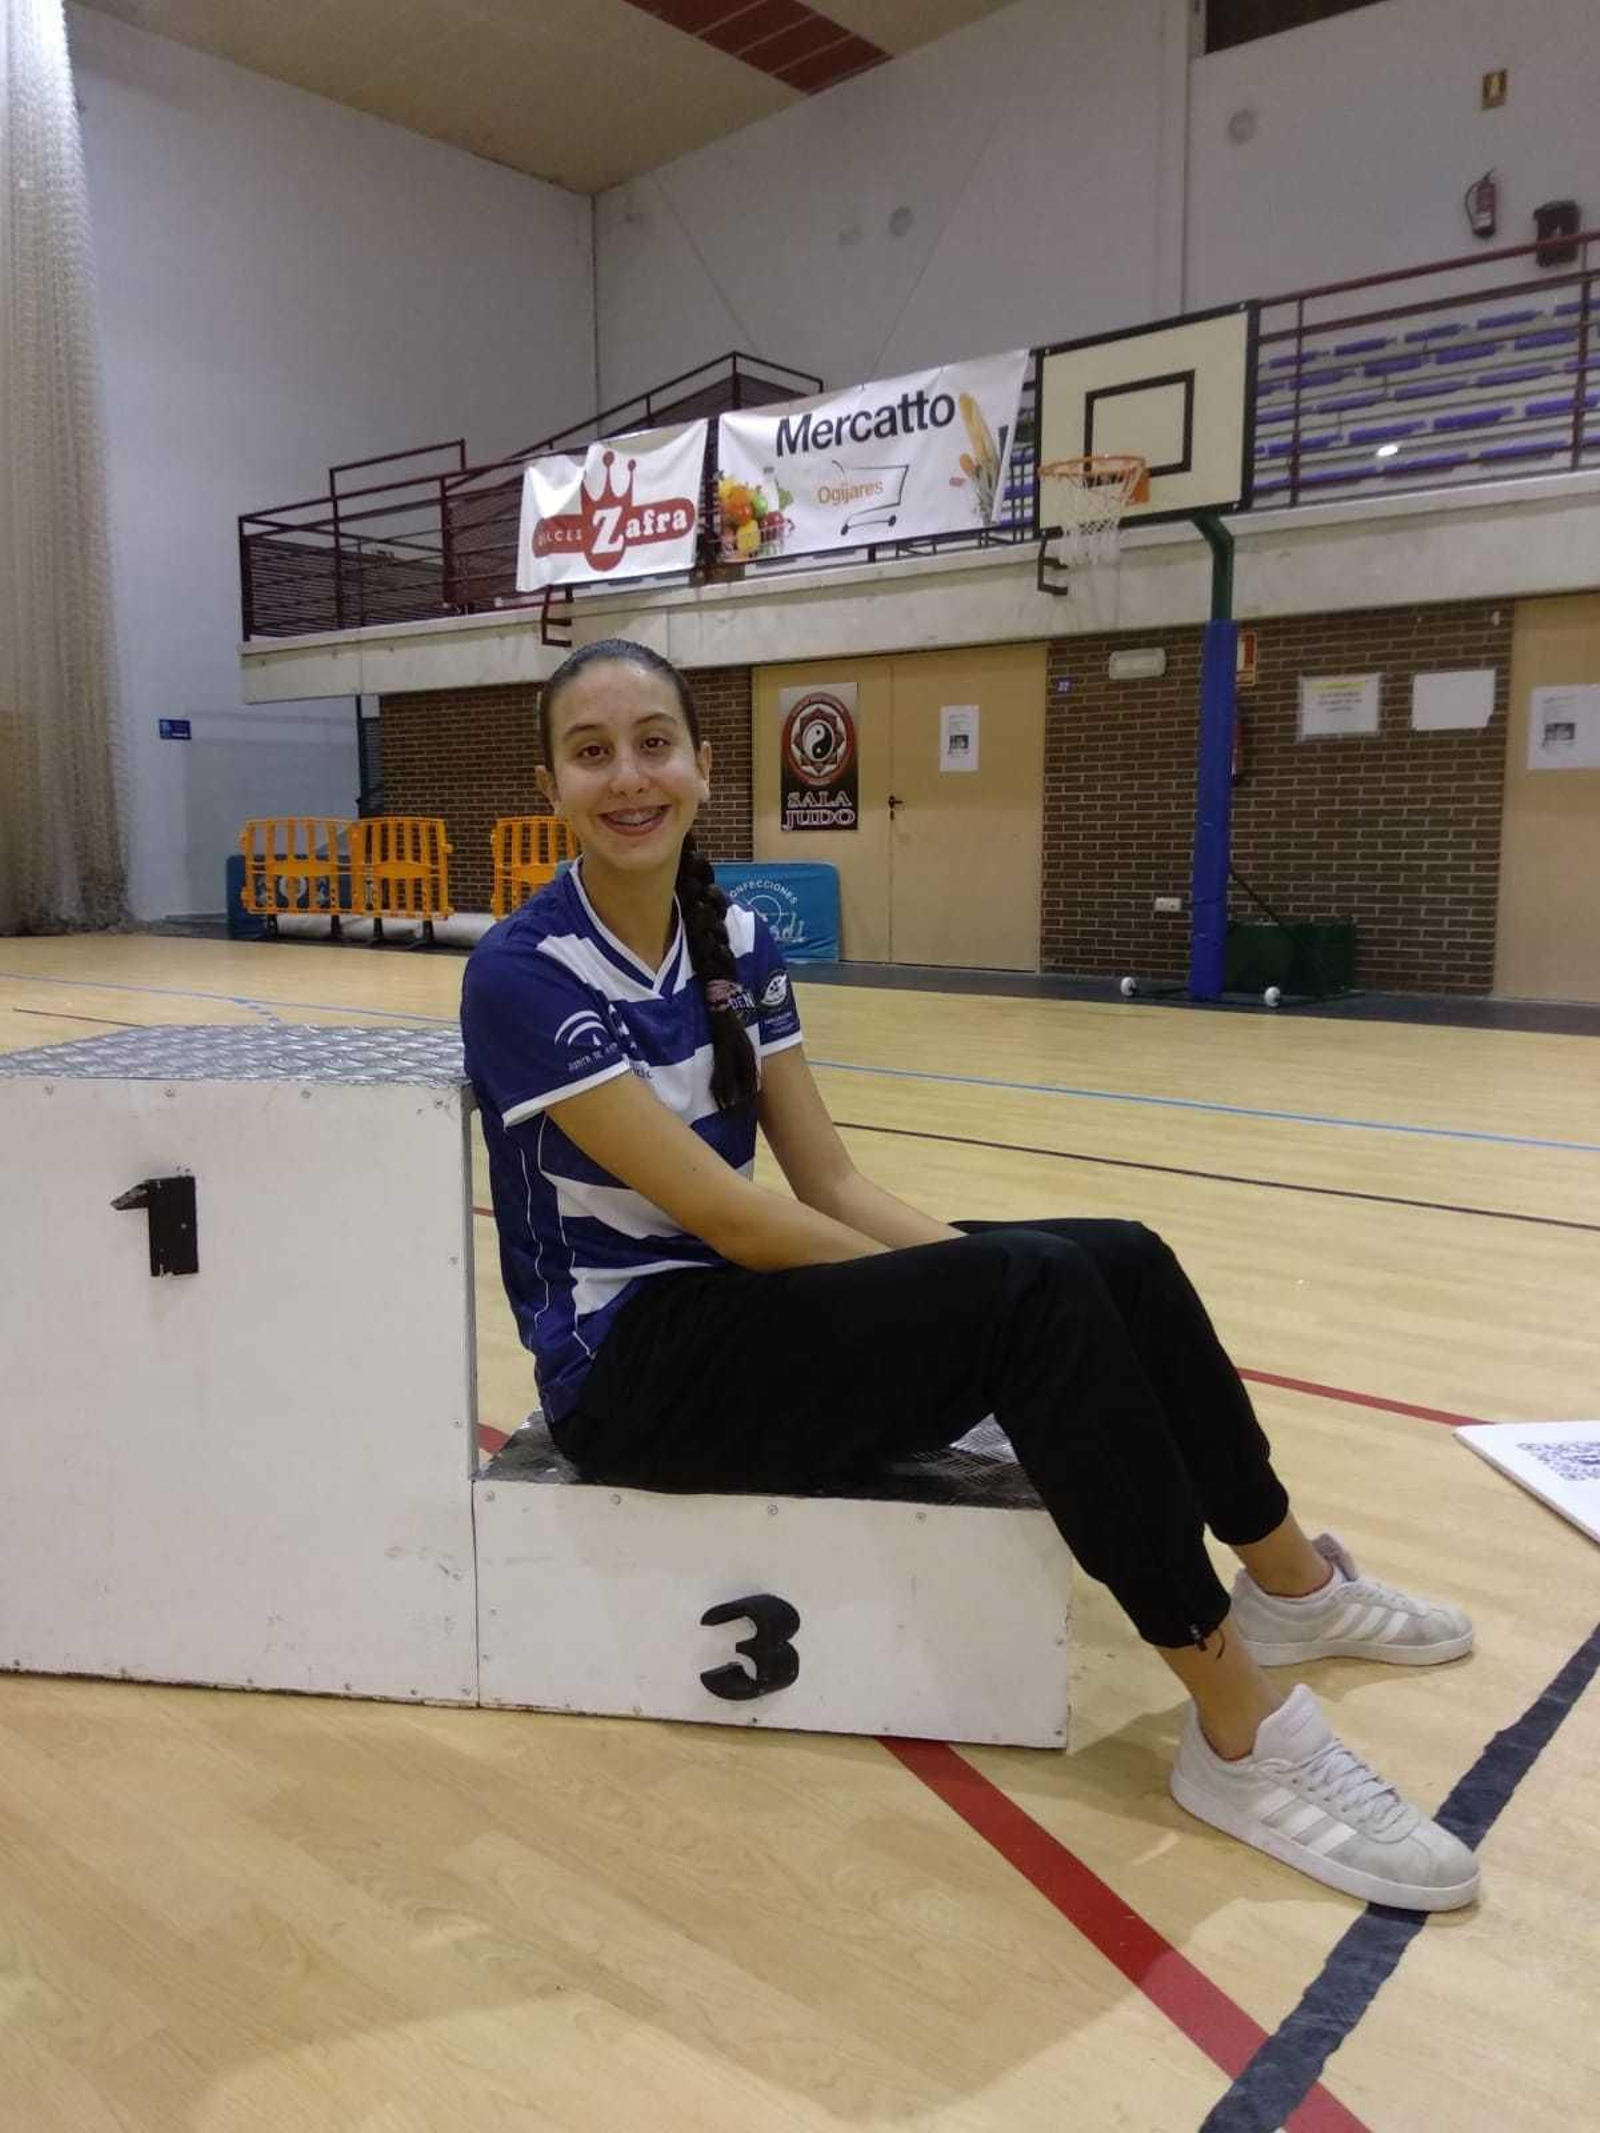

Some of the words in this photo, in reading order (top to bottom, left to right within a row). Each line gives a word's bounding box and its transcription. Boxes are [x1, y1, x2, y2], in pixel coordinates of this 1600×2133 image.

[776, 390, 956, 457] Mercatto
[592, 505, 689, 554] Zafra
[787, 790, 853, 808] SALA
[728, 879, 798, 905] ONFECCIONES
[109, 1175, 199, 1277] 1
[700, 1593, 800, 1701] 3
